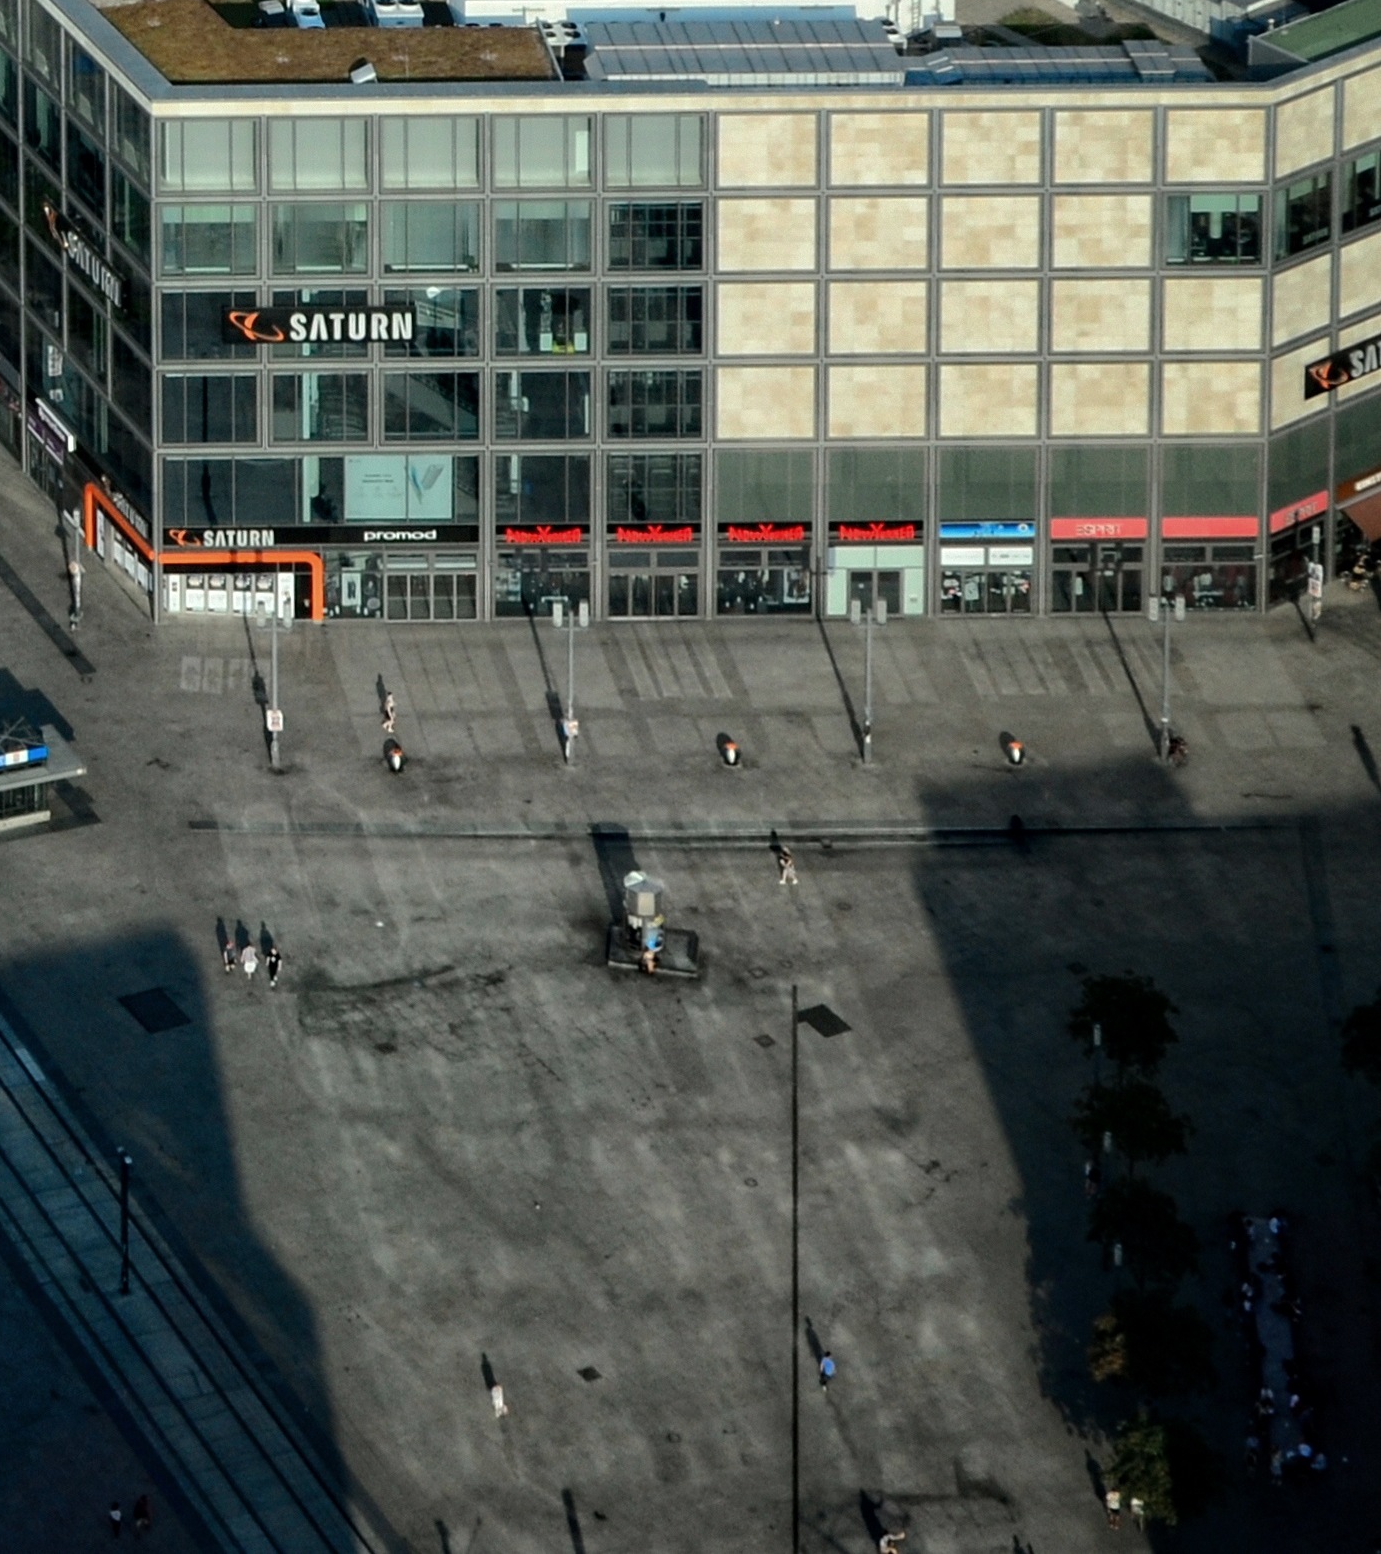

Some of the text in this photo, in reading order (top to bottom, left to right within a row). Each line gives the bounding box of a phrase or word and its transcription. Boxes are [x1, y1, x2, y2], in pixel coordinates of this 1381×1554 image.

[67, 230, 122, 308] SATURN
[290, 312, 413, 342] SATURN
[203, 529, 275, 547] SATURN
[363, 529, 437, 543] promod
